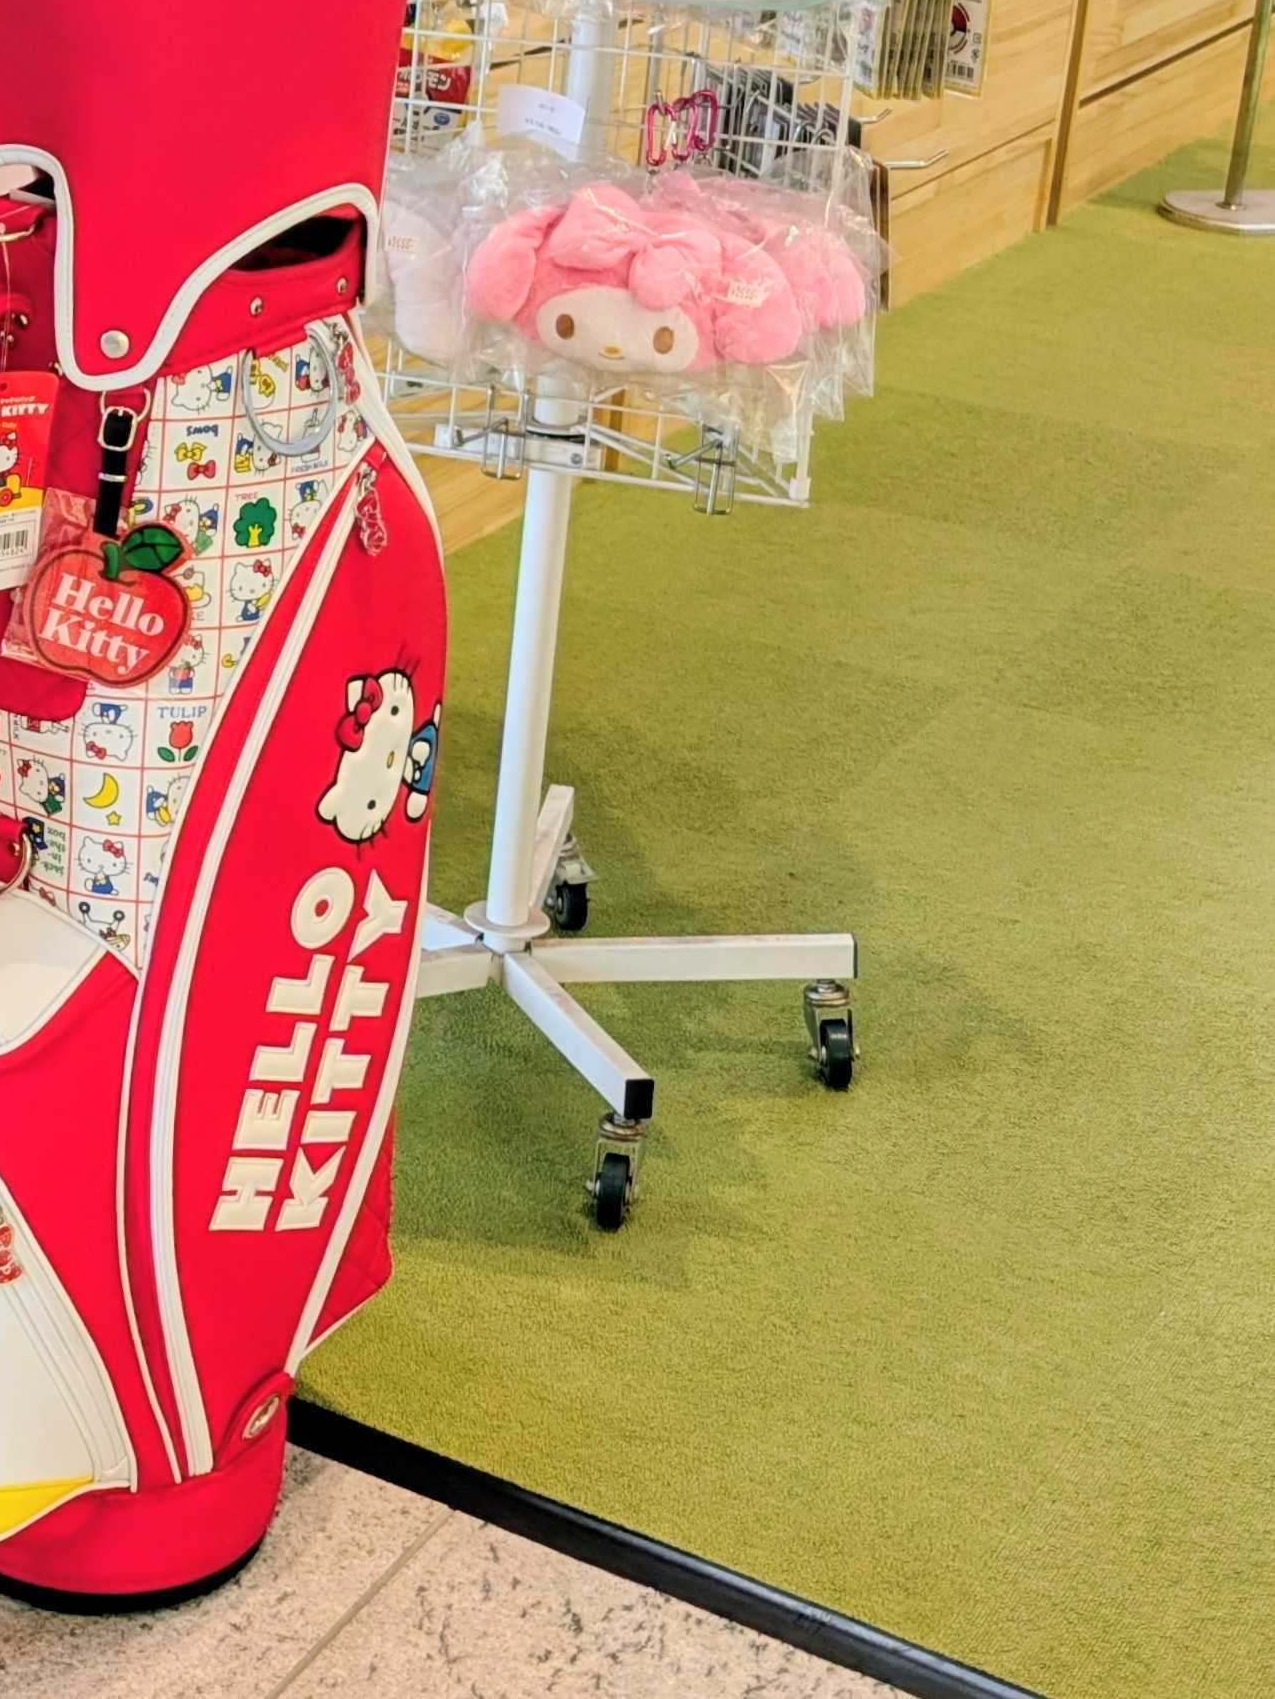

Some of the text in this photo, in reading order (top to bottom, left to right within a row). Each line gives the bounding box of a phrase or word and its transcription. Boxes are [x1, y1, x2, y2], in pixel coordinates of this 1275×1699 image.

[0, 402, 50, 418] KITTY
[186, 424, 219, 438] bows
[53, 572, 164, 637] Hello
[41, 606, 150, 674] Kitty
[157, 705, 207, 719] TULIP
[208, 866, 355, 1232] HELLO
[275, 868, 408, 1233] KITTY
